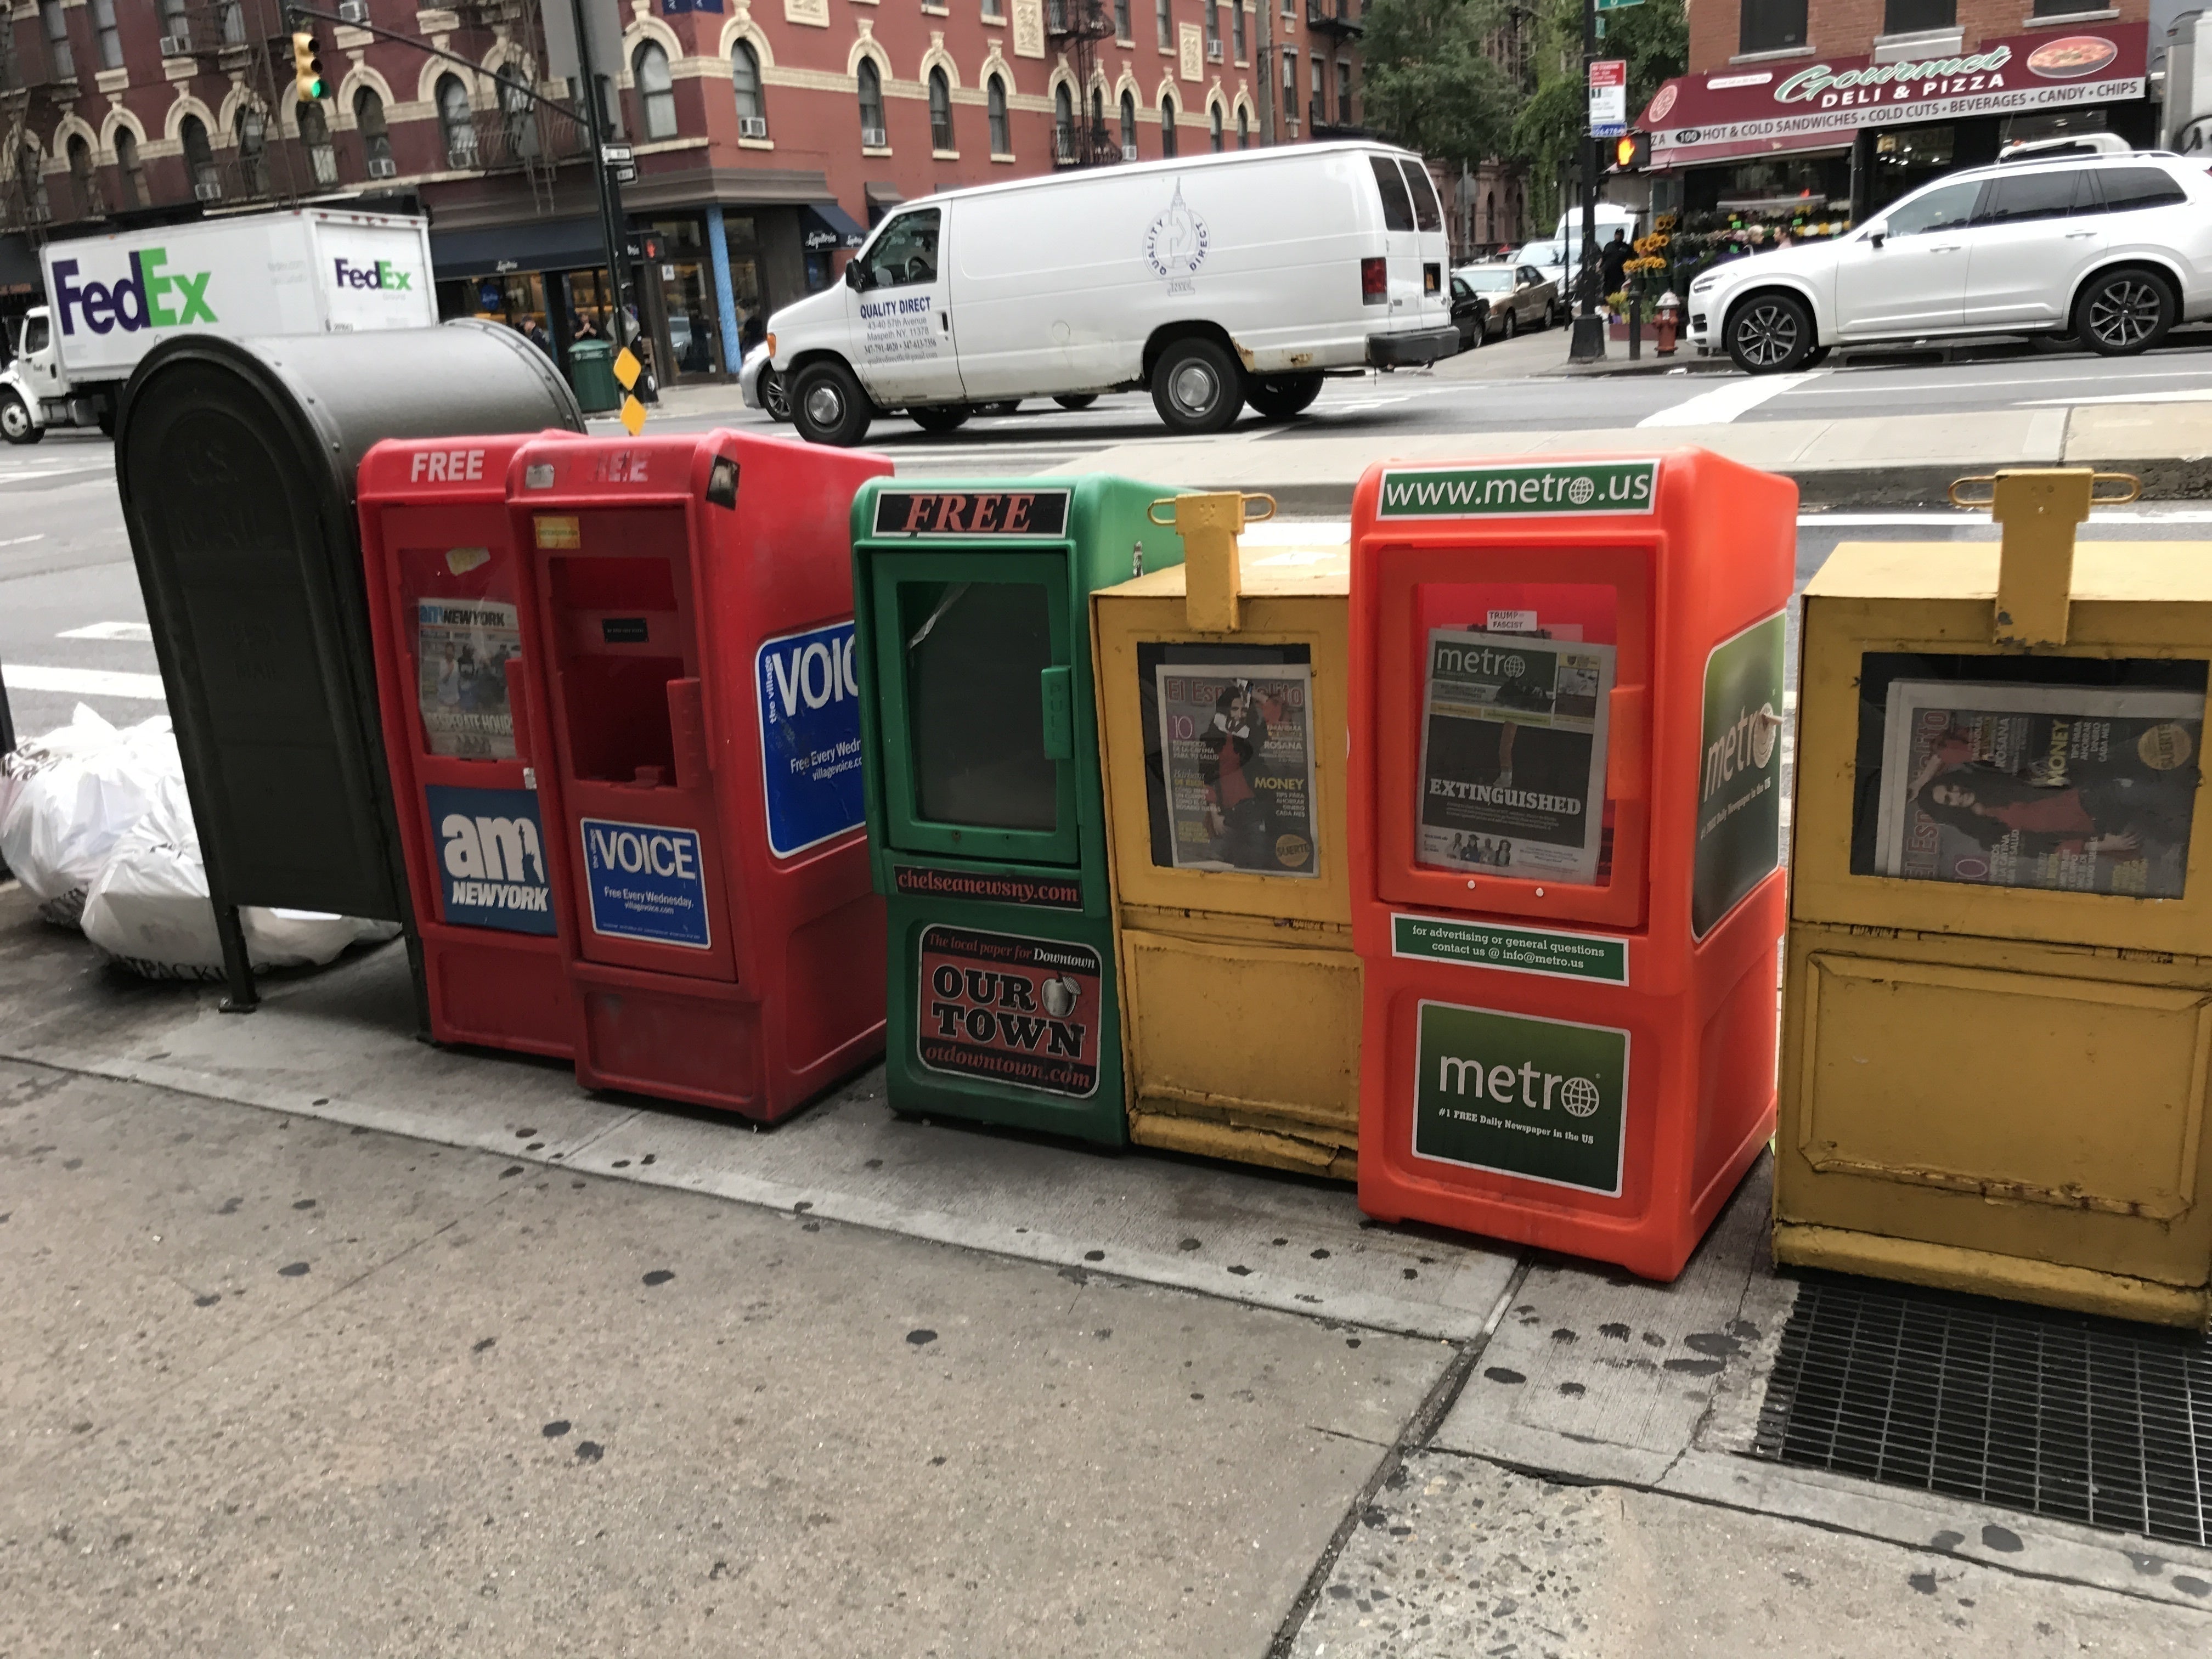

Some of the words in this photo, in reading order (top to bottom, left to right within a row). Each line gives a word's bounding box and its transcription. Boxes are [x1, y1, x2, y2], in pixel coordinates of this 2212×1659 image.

[1774, 46, 2012, 103] Gourmet
[1821, 88, 1881, 108] DELI
[1893, 85, 1910, 99] &
[1922, 74, 2005, 96] PIZZA
[1702, 127, 1728, 140] HOT
[1730, 126, 1739, 137] &
[1741, 122, 1773, 136] COLD
[1776, 112, 1858, 132] SANDWICHES
[1869, 107, 1903, 122] COLD
[1906, 103, 1939, 117] CUTS
[1949, 93, 2026, 112] BEVERAGES
[2038, 87, 2086, 103] CANDY
[2097, 81, 2137, 97] CHIPS
[1147, 218, 1166, 276] QUALITY
[1189, 222, 1207, 272] DIRECT
[335, 258, 412, 290] FedEx
[52, 247, 218, 336] FedEx
[860, 301, 897, 320] QUALITY
[899, 296, 931, 314] DIRECT
[867, 331, 895, 342] Maspeth
[902, 317, 927, 326] Avenue
[411, 449, 486, 482] FREE
[1386, 473, 1650, 506] www.metro.us
[901, 494, 1036, 532] FREE
[765, 655, 775, 700] village
[772, 633, 858, 718] VOIC
[1437, 648, 1525, 678] metro
[1172, 715, 1193, 740] 10
[791, 756, 810, 774] Free
[811, 746, 835, 766] Every
[1264, 741, 1302, 750] ROSANA
[1704, 702, 1776, 803] metro
[2047, 719, 2070, 786] MONEY
[2100, 741, 2109, 762] CADA
[1254, 777, 1305, 790] MONEY
[1430, 778, 1581, 815] EXTINGUISHED
[442, 814, 545, 884] am
[595, 829, 696, 879] VOICE
[2010, 828, 2019, 855] SALUD
[452, 882, 548, 912] NEWYORK
[604, 885, 621, 899] Free
[623, 888, 645, 902] Every
[646, 890, 694, 910] Wednesday,
[898, 870, 1079, 902] chelseanewsny.com
[624, 900, 674, 915] villagevoice.com
[928, 933, 949, 947] The
[951, 939, 979, 953] local
[979, 944, 1013, 959] paper
[1014, 945, 1032, 962] for
[1034, 947, 1096, 970] Downtown
[1412, 925, 1427, 936] for
[1430, 928, 1488, 945] advertising
[1491, 936, 1504, 945] or
[1505, 936, 1547, 951] general
[1550, 941, 1605, 958] questions
[1432, 941, 1470, 955] contact
[1472, 947, 1485, 957] us
[1488, 947, 1500, 960] @
[1503, 949, 1584, 969] info@metro.us
[932, 963, 1038, 1012] OUR
[932, 1001, 1086, 1060] TOWN
[926, 1045, 1091, 1088] otdowntown.com
[1439, 1055, 1600, 1118] metro
[1438, 1108, 1451, 1118] #1
[1454, 1110, 1478, 1122] FREE
[1480, 1114, 1503, 1129] Daily
[1504, 1119, 1551, 1137] Newspaper
[1553, 1128, 1562, 1138] in
[1565, 1131, 1579, 1142] the
[1582, 1135, 1594, 1145] US
